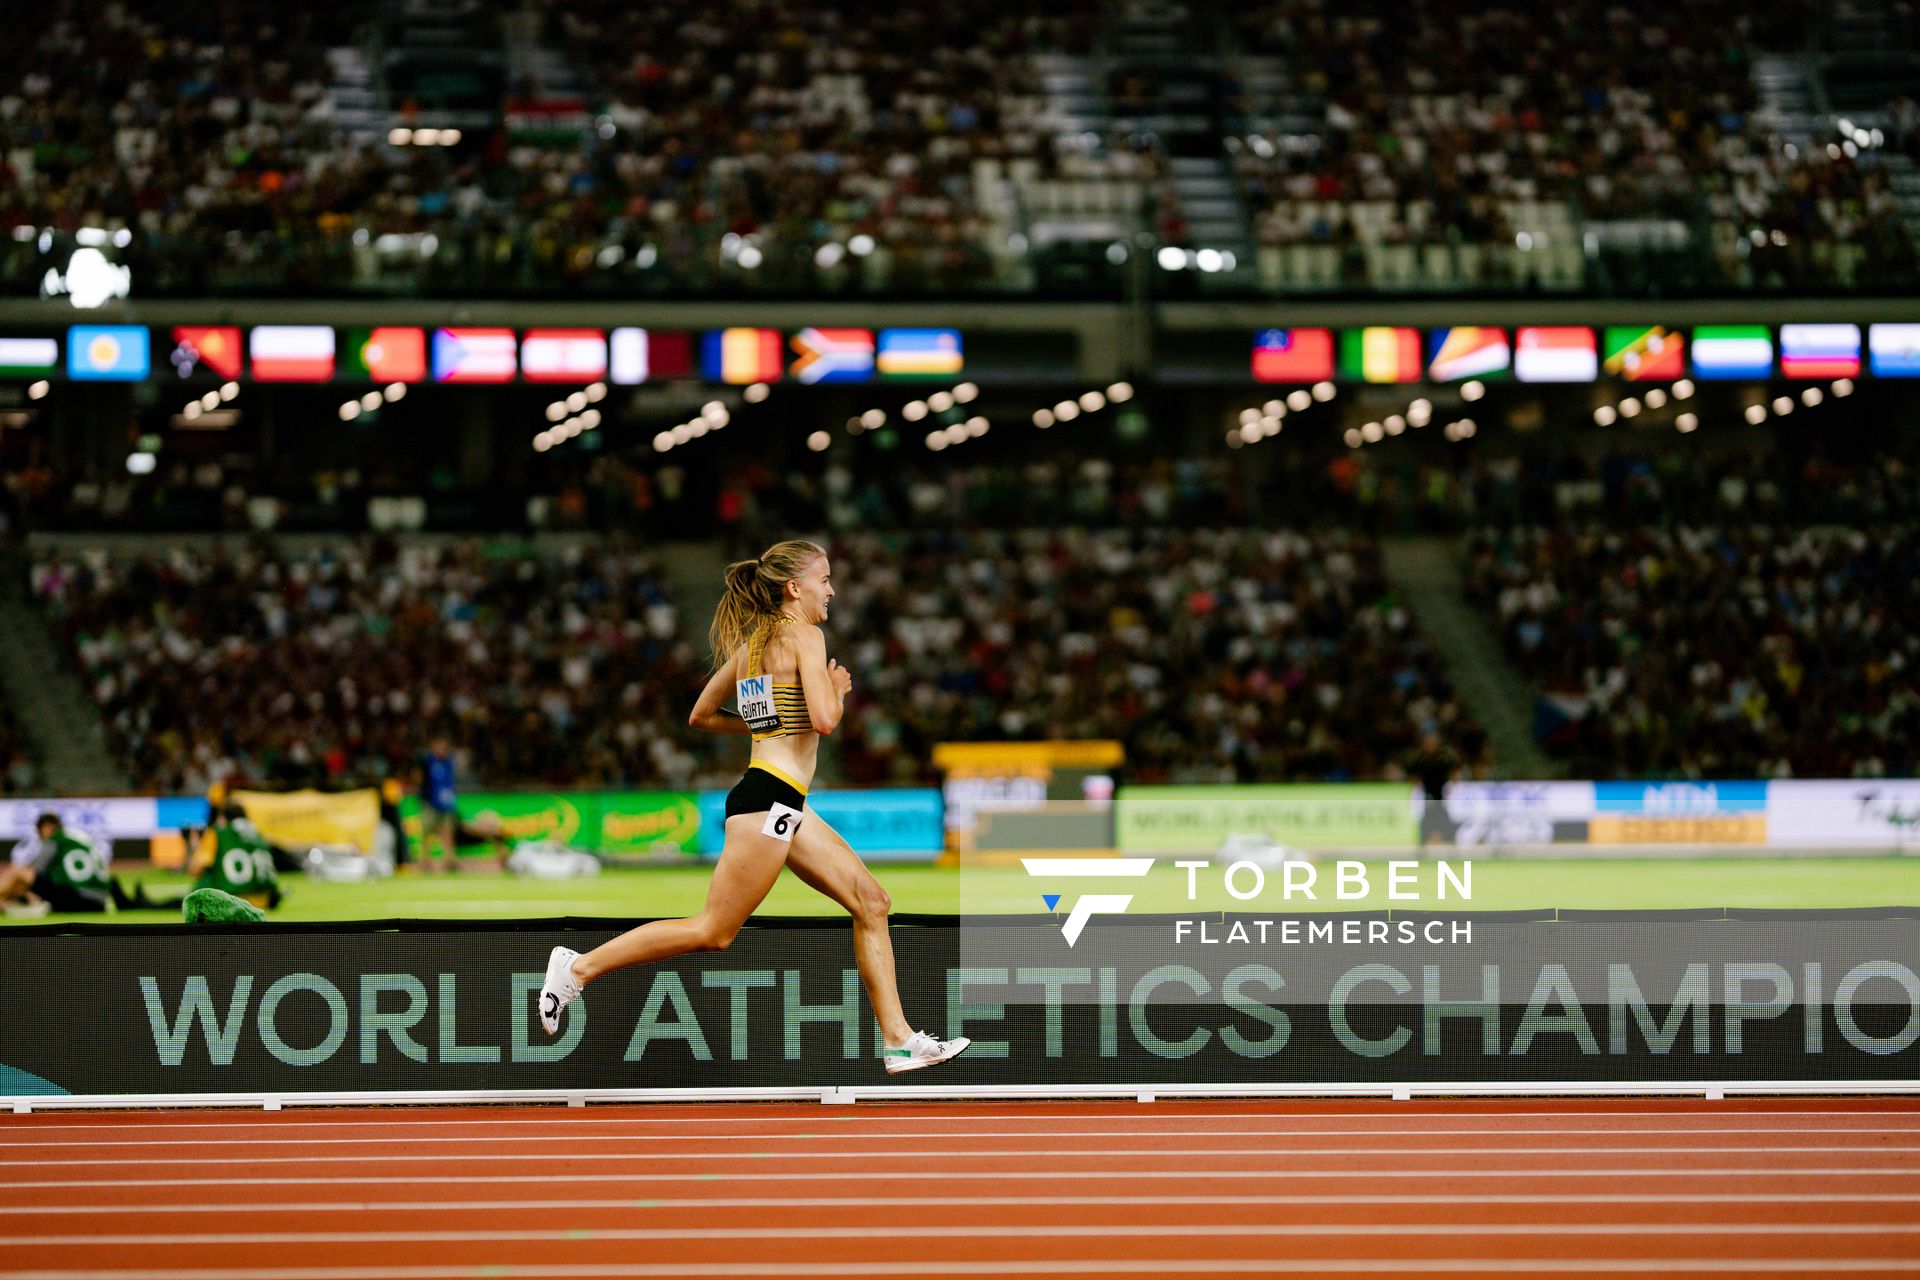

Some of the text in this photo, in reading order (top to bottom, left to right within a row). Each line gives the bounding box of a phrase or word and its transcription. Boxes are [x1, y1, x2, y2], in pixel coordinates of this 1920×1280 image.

[740, 677, 764, 697] NTN
[774, 813, 792, 835] 6
[137, 960, 1920, 1067] WORLD ATHETICS CHAMPIO
